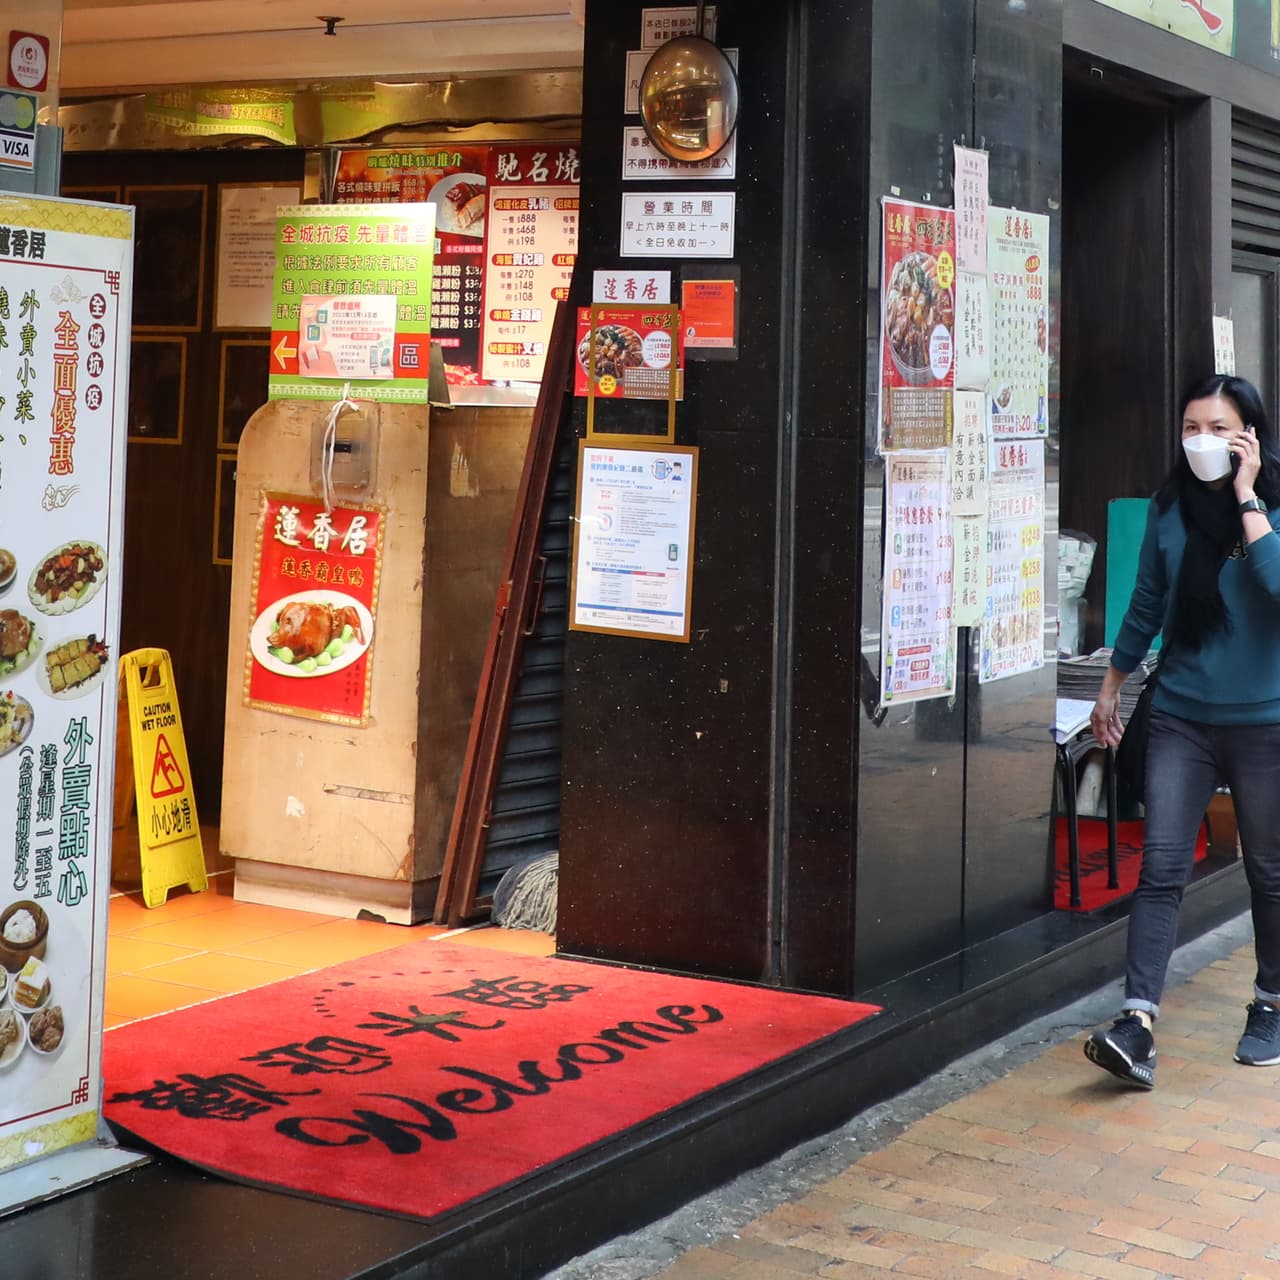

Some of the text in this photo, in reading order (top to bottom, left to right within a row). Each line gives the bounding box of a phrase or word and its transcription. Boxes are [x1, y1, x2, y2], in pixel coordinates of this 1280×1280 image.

[1, 138, 30, 158] VISA
[643, 200, 714, 215] 營業時間
[281, 223, 427, 244] 全城抗疫 先量體溫
[625, 221, 730, 232] 早上六時至晚上十一時
[888, 212, 911, 235] 蓮香居
[1004, 215, 1028, 239] 蓮香居
[283, 255, 419, 272] 根據法例要求所有顧客
[282, 279, 418, 295] 進入食肆前須先量體溫
[603, 277, 659, 302] 蓮香居
[86, 293, 107, 411] 全城抗疫
[48, 311, 82, 476] 全面優惠
[1000, 444, 1024, 469] 蓮香居
[273, 505, 370, 557] 蓮香居
[281, 557, 365, 588] 蓮香霸皇鴨
[143, 701, 172, 718] CAUTION
[141, 715, 177, 733] WET FLOOR
[56, 718, 93, 907] 外賣點心
[151, 796, 193, 840] 小心地滑
[276, 1001, 724, 1155] Welcome
